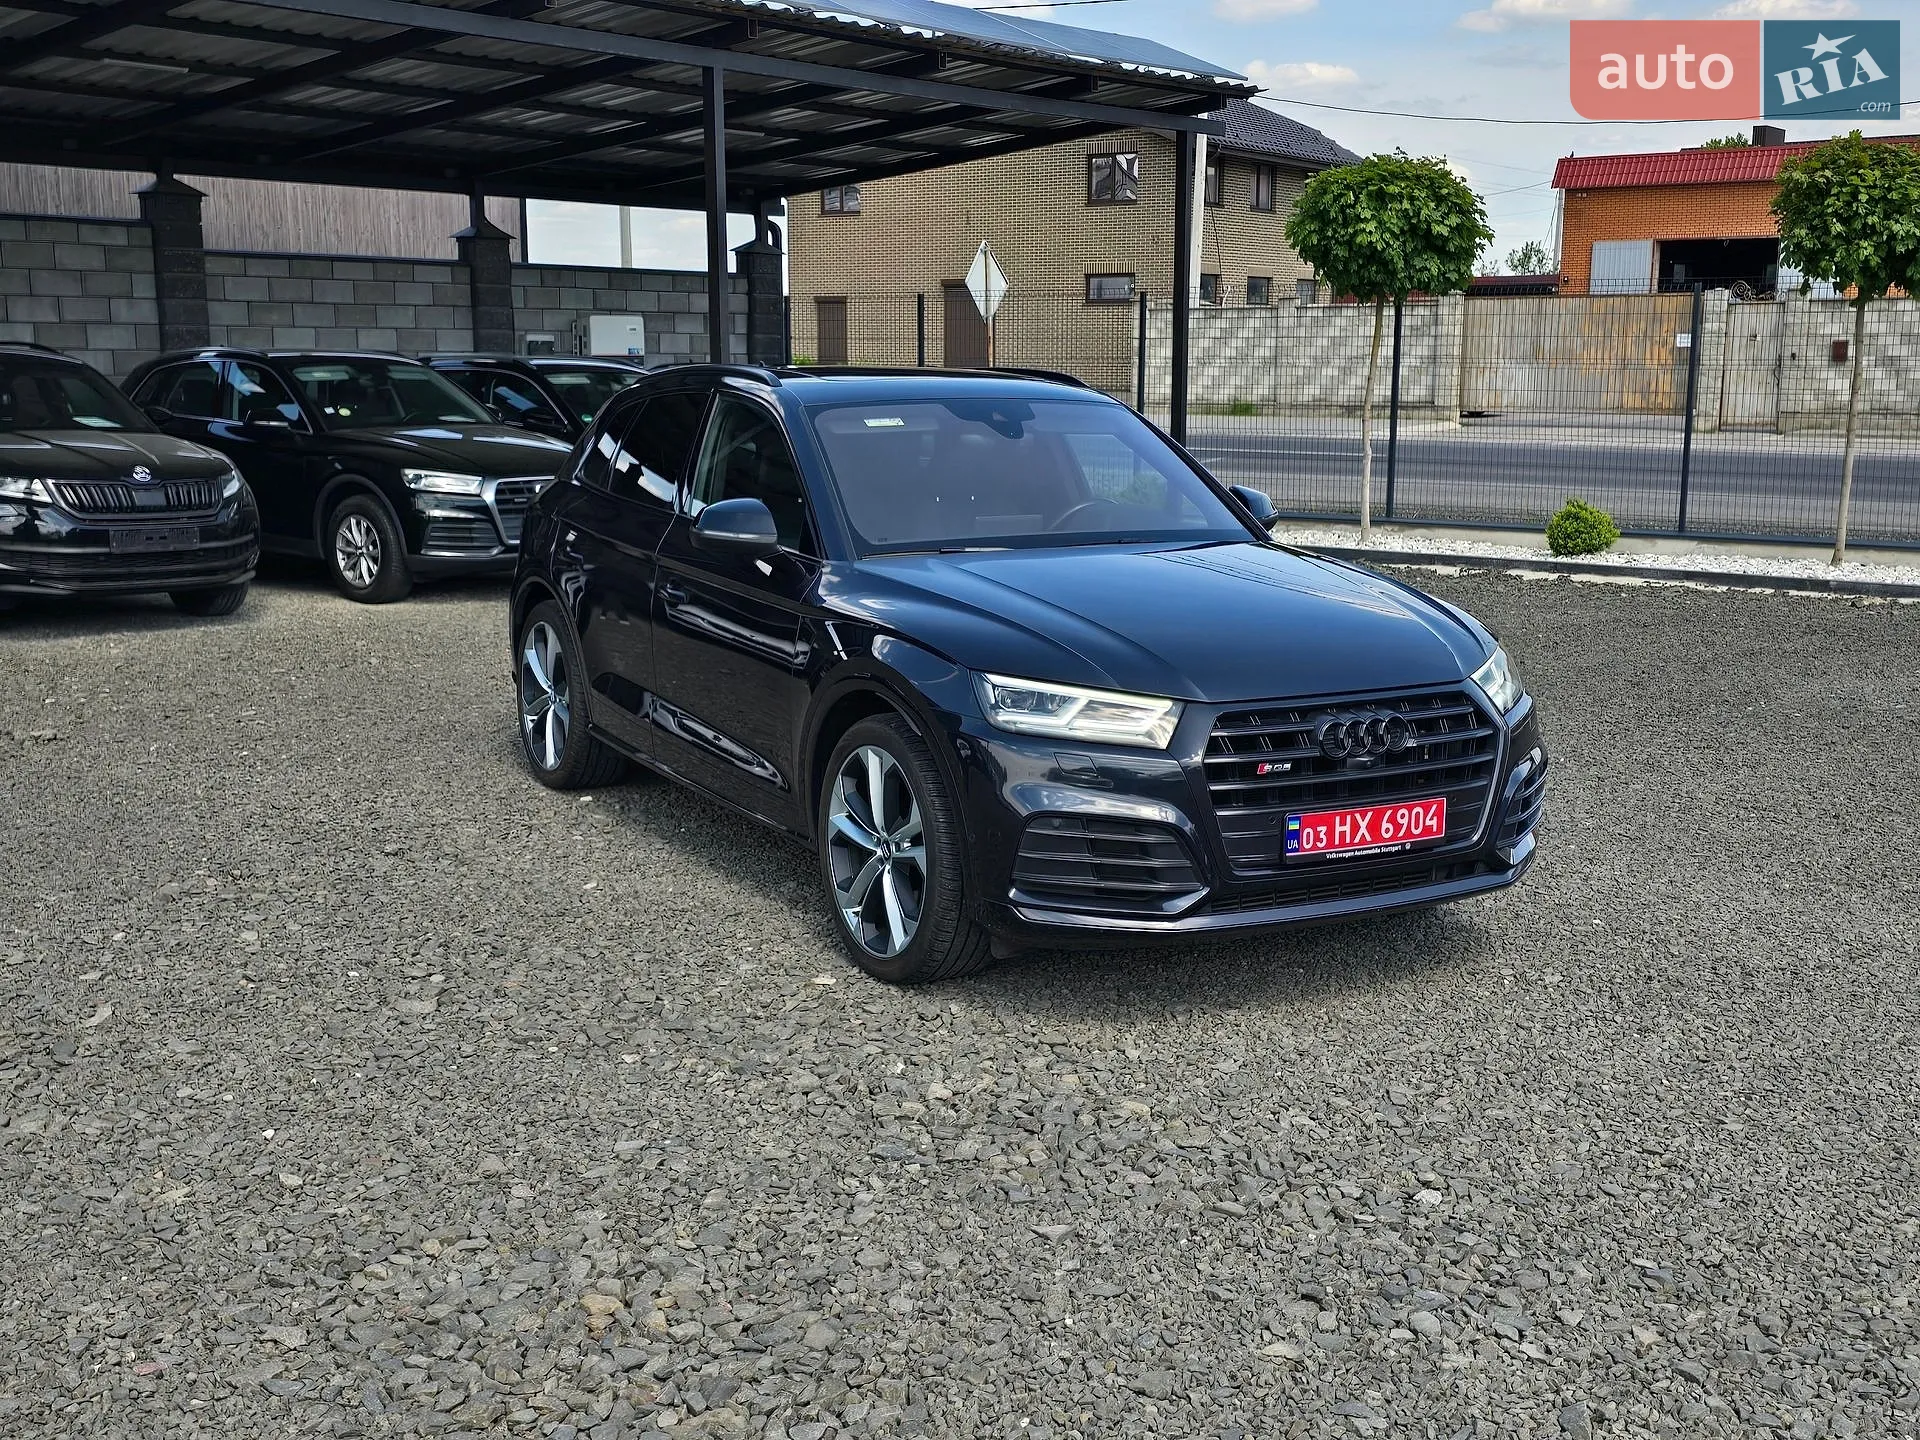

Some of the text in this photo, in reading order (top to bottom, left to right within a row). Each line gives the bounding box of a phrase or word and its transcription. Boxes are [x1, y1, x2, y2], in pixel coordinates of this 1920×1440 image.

[1302, 804, 1438, 849] 03 HX 6904
[1287, 839, 1299, 849] UA
